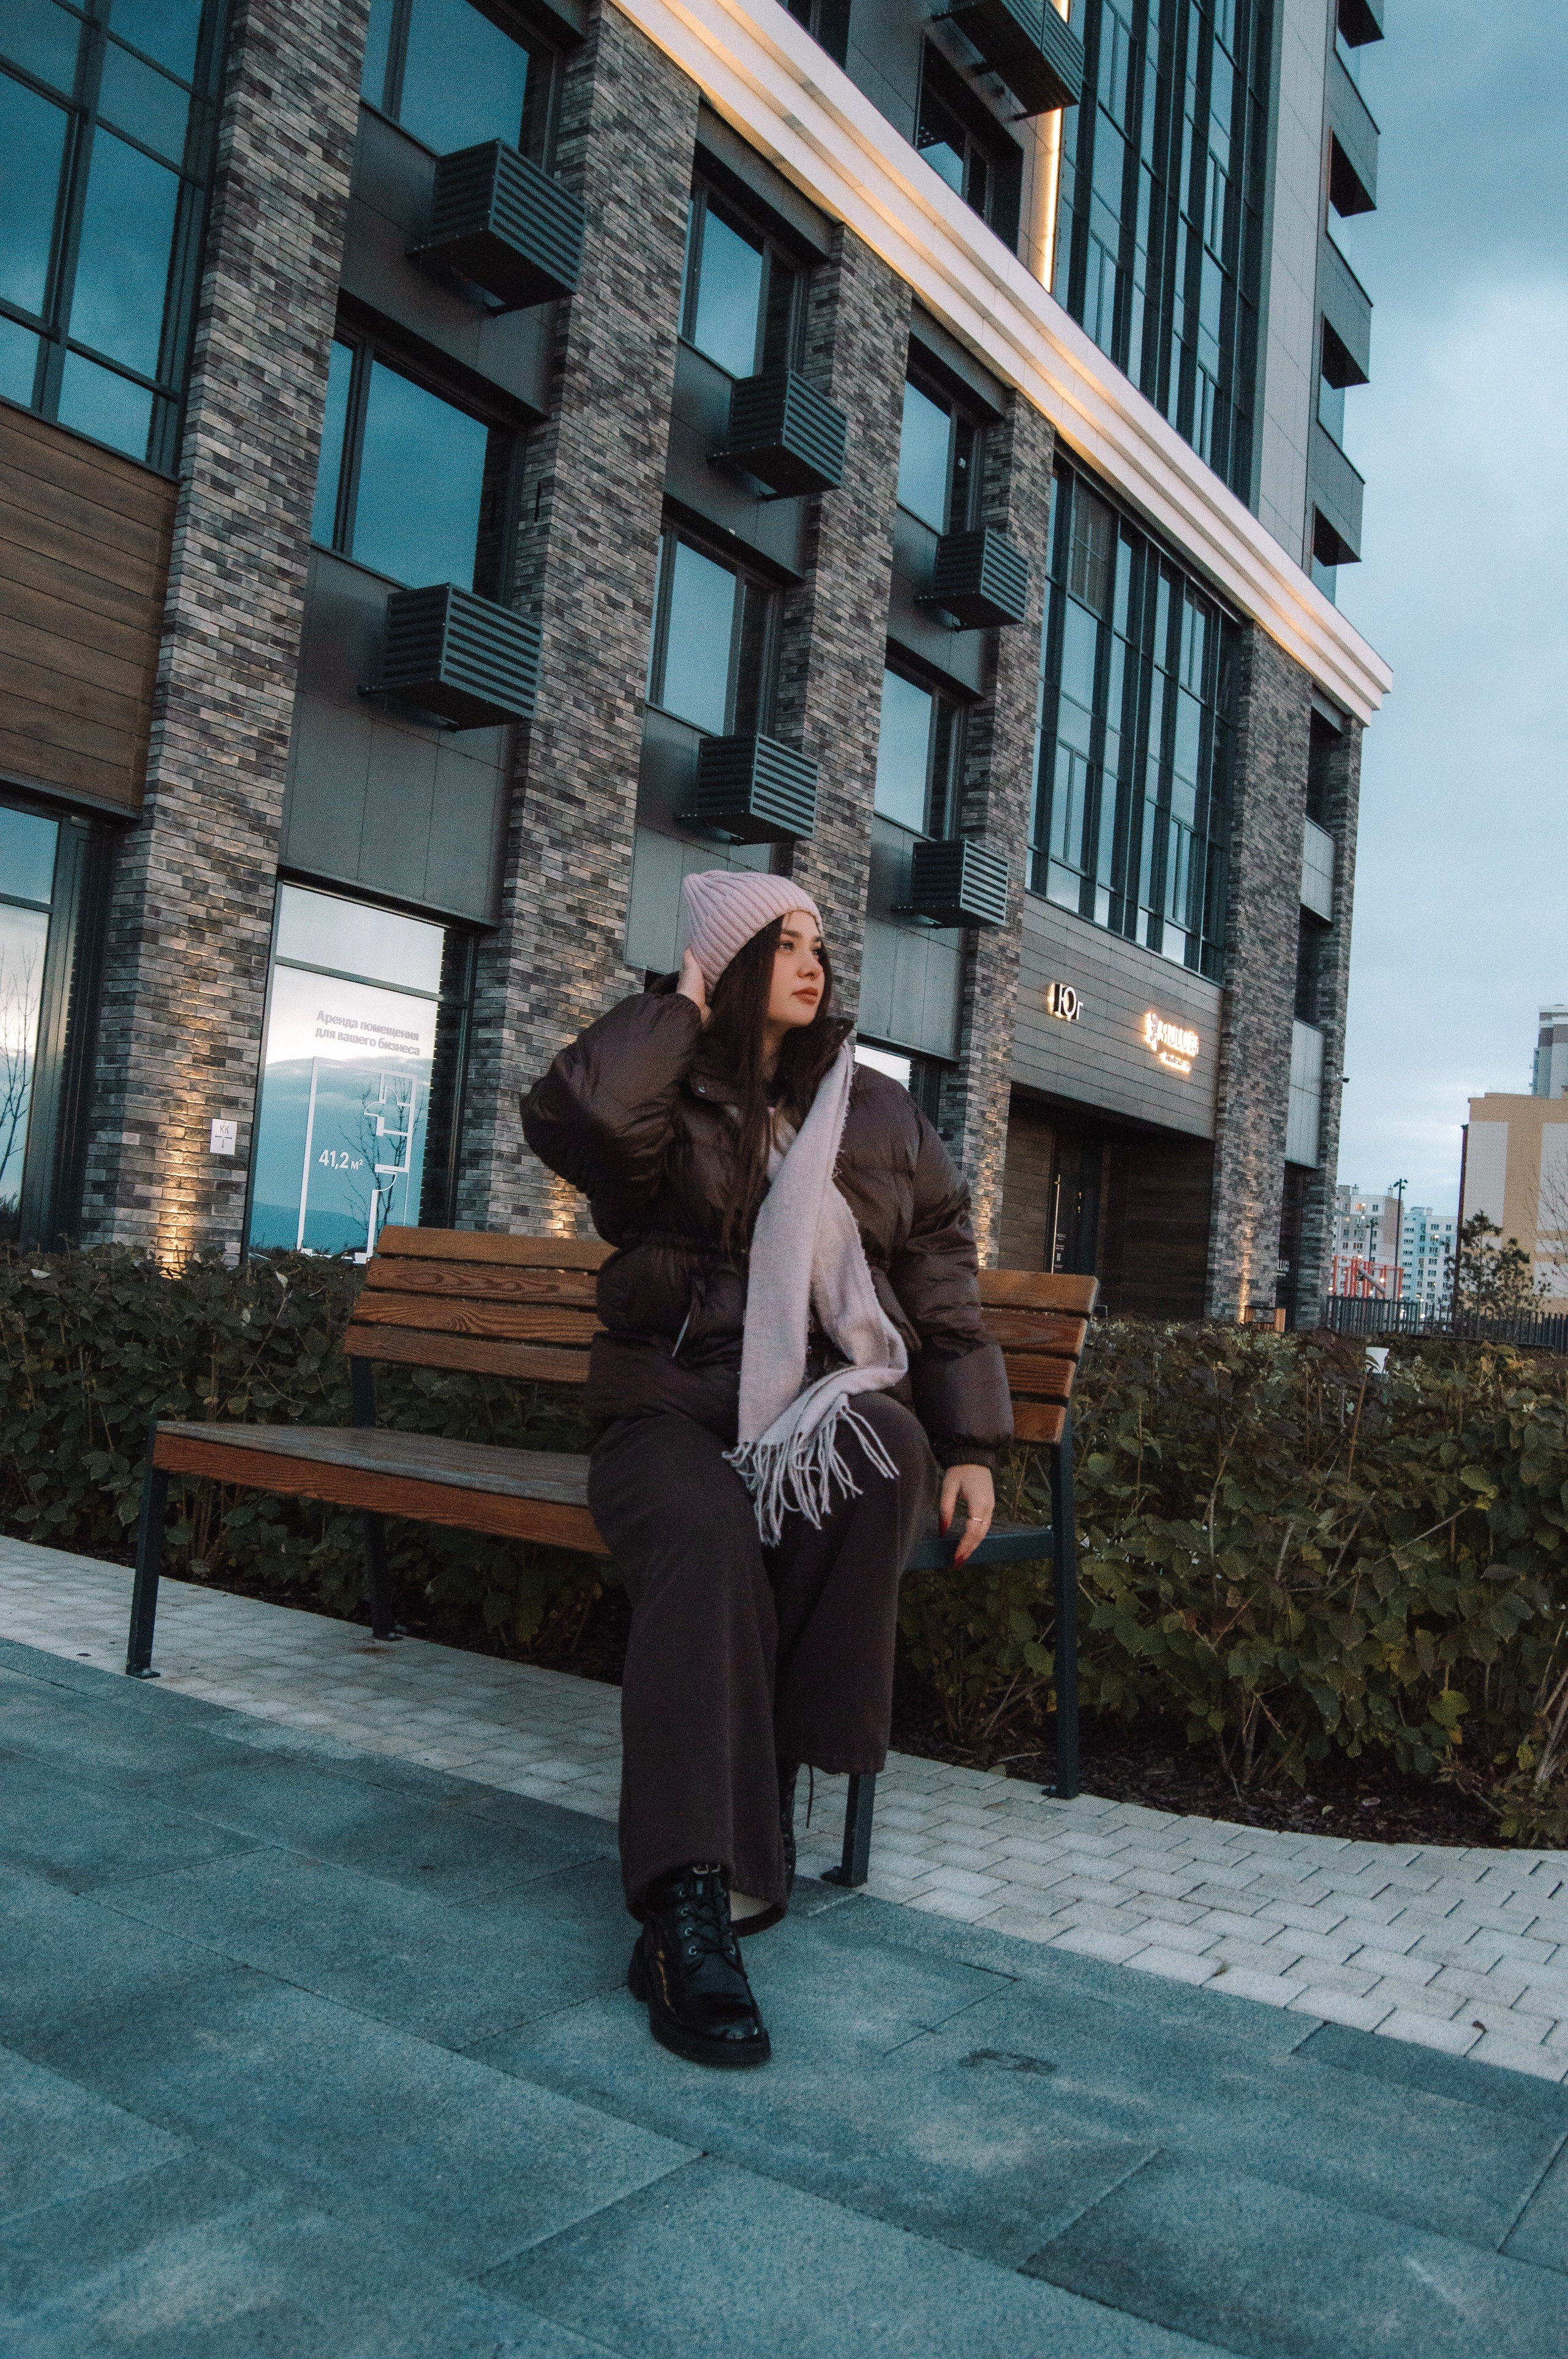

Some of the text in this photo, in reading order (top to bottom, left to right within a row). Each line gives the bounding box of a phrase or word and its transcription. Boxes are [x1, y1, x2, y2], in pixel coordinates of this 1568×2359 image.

[1058, 984, 1084, 1020] Юг
[317, 1010, 420, 1041] Аренда помещения
[315, 1028, 420, 1056] для вашего бизнеса
[318, 1149, 350, 1170] 41,2
